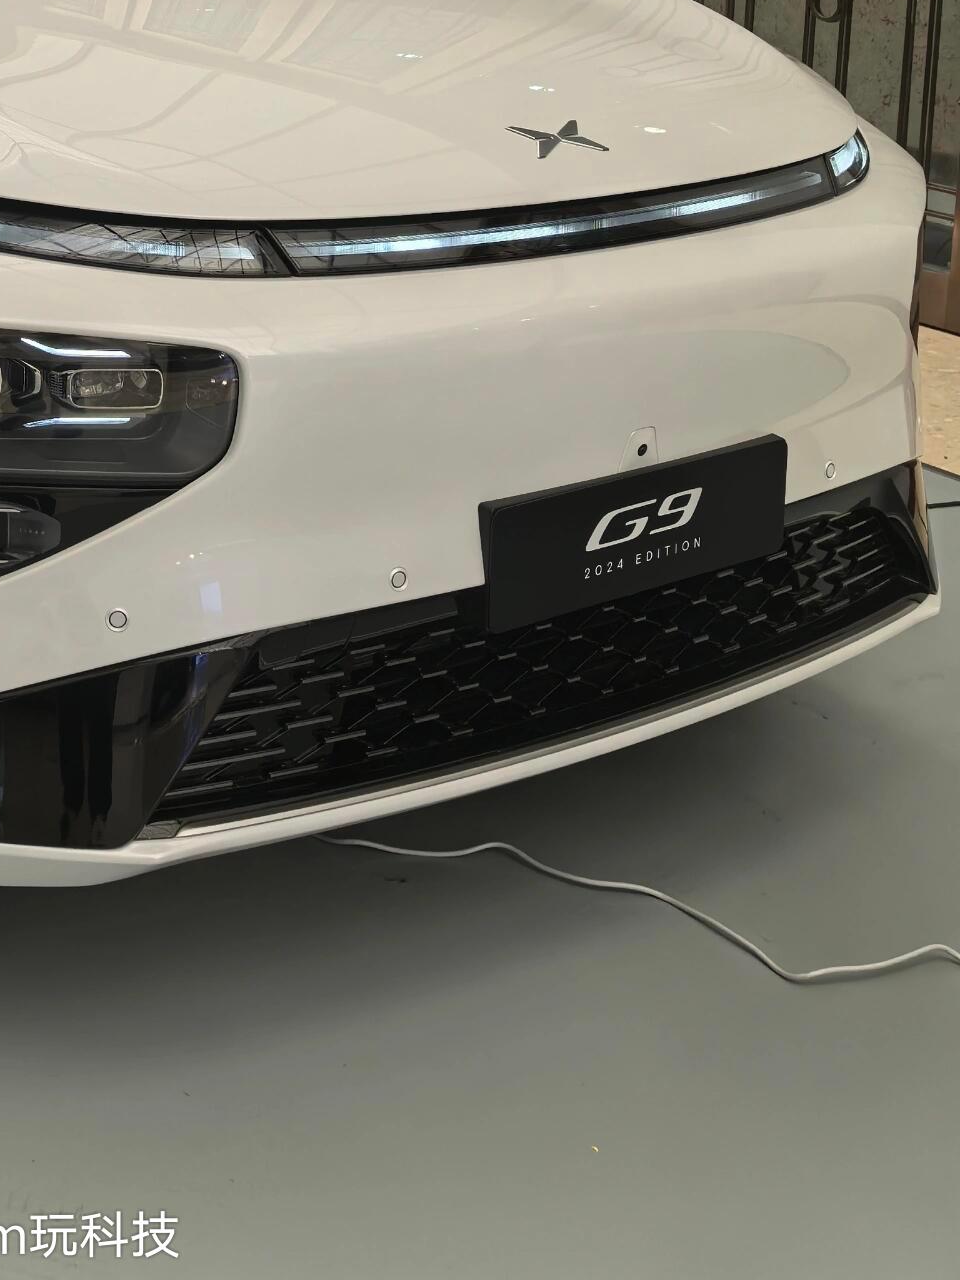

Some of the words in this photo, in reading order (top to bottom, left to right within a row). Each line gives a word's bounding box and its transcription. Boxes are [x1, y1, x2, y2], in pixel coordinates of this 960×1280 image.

[585, 487, 703, 552] G9
[584, 558, 624, 580] 2024
[635, 536, 702, 565] EDITION
